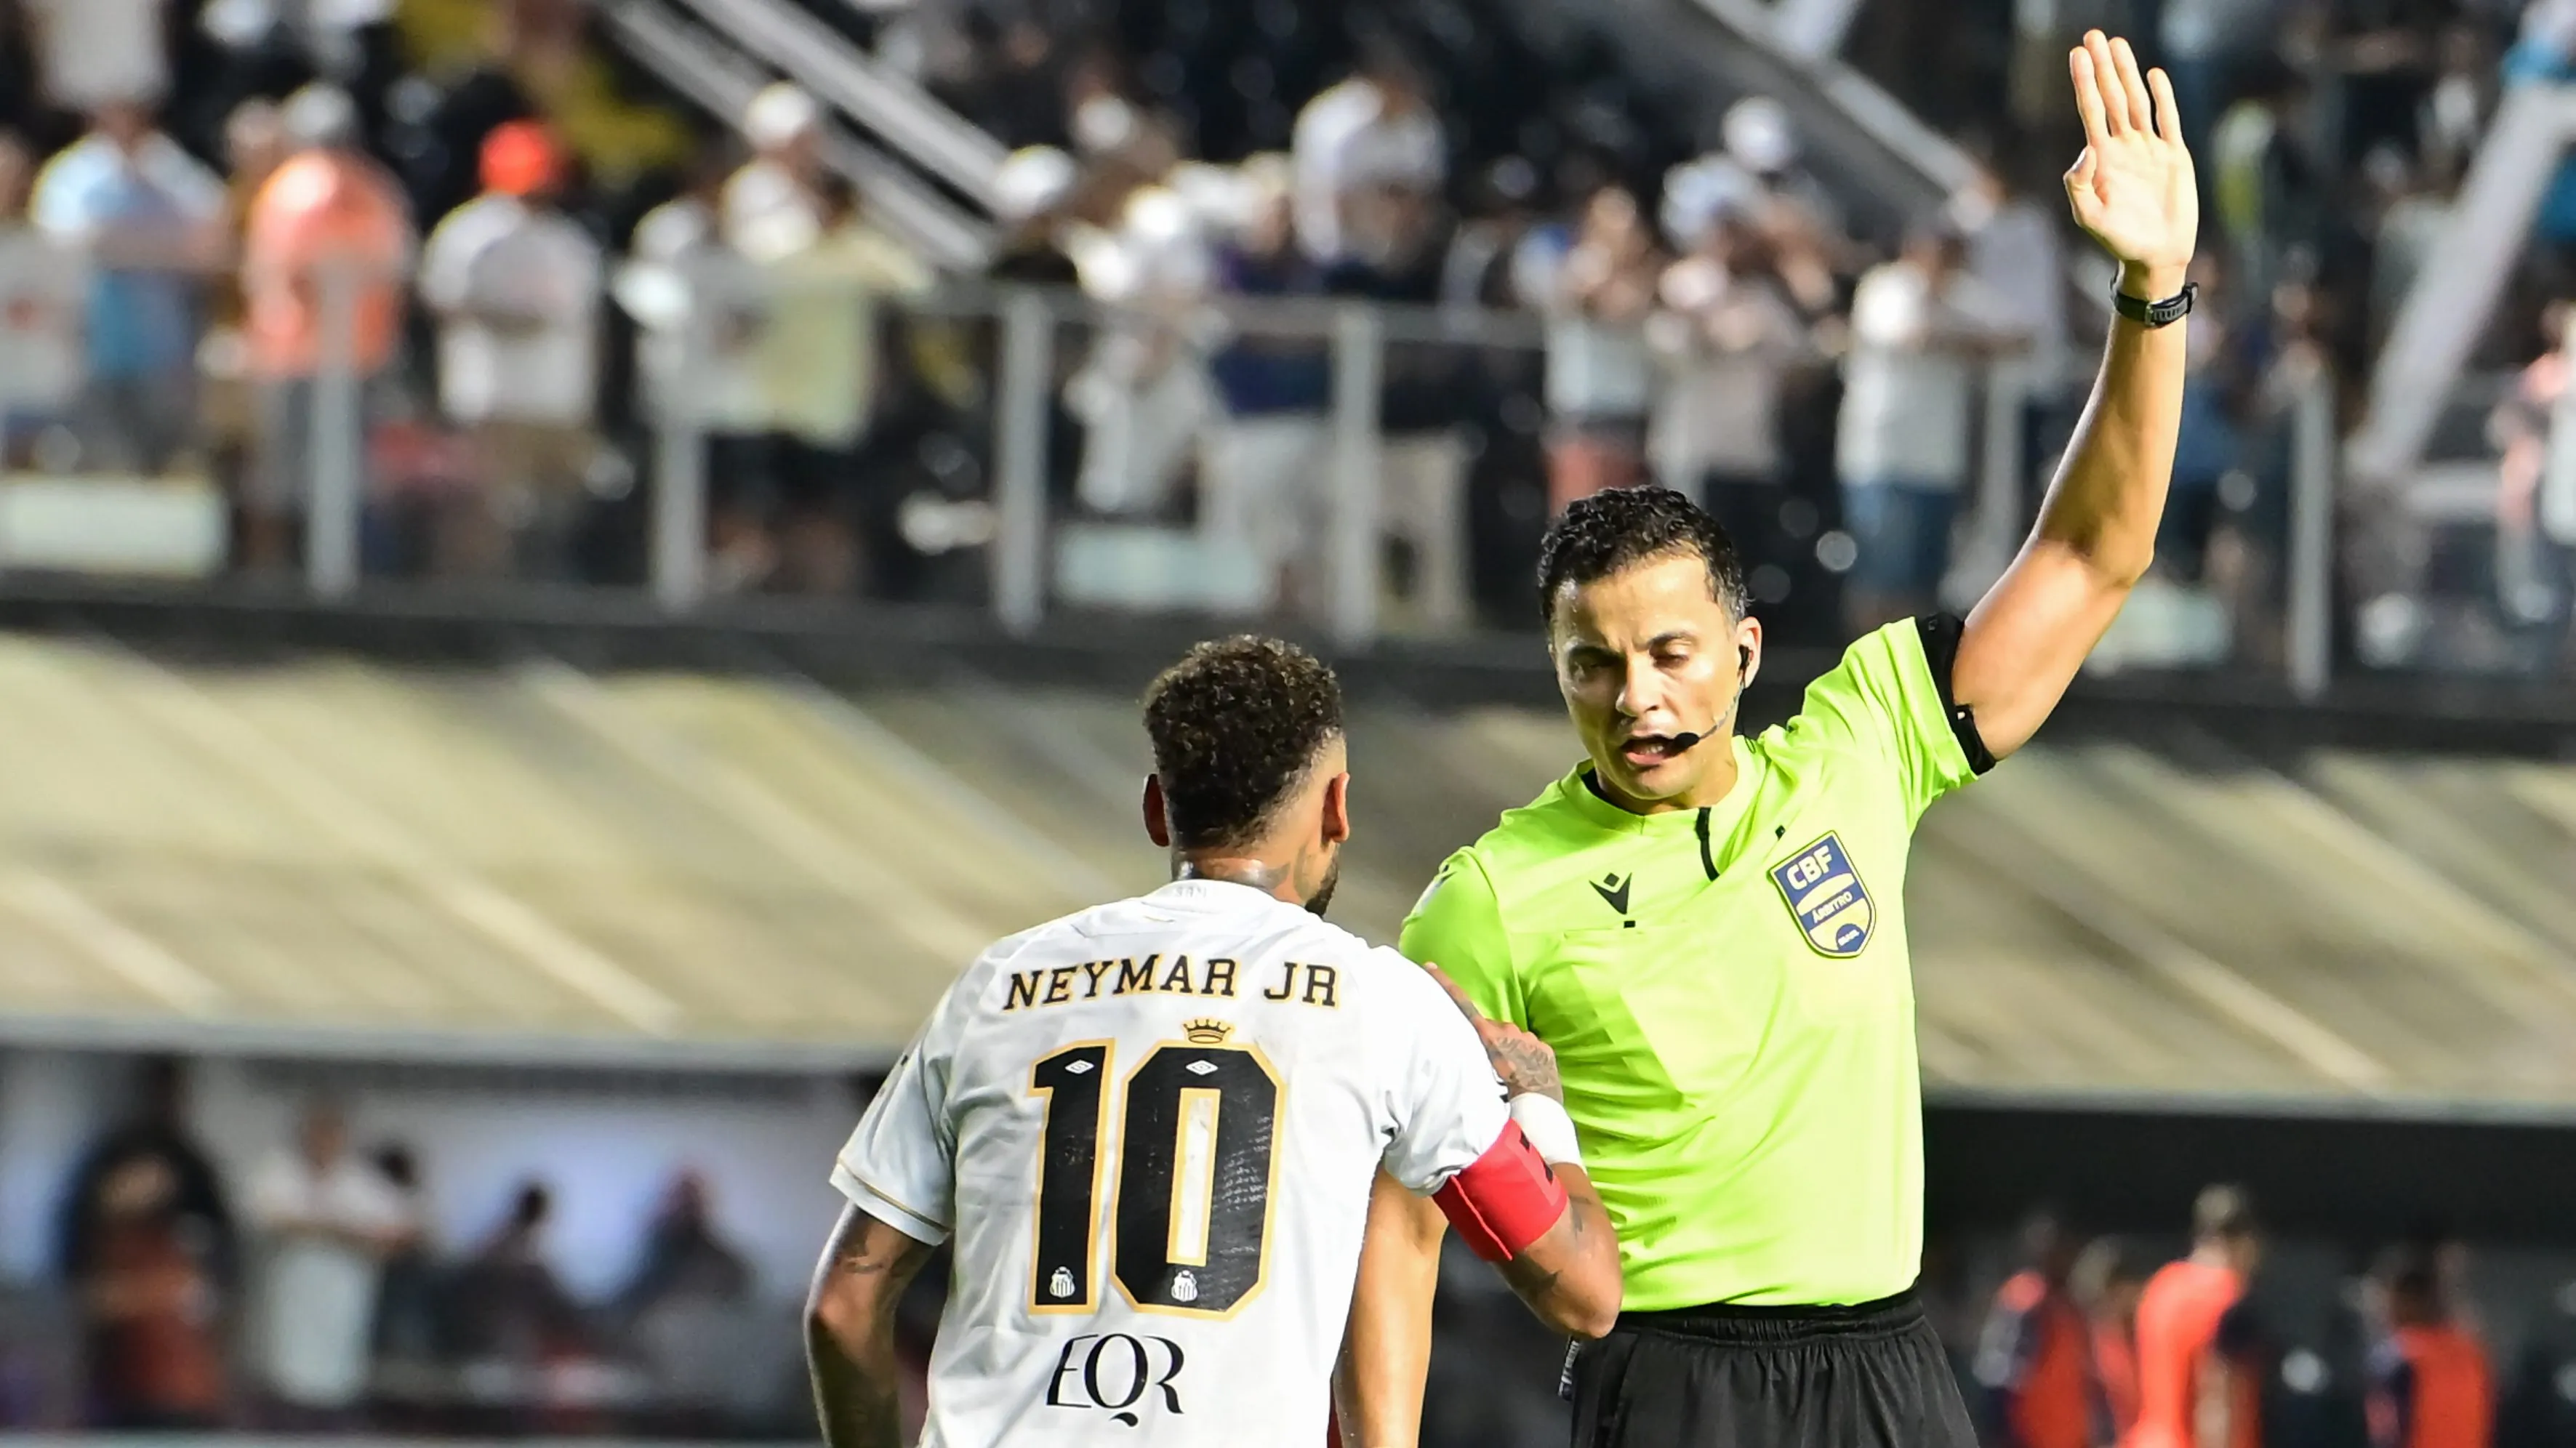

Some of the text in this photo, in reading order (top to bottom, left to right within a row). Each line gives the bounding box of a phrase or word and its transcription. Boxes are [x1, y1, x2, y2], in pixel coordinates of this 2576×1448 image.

[1786, 845, 1832, 890] CBF
[1003, 953, 1339, 1012] NEYMAR JR
[1028, 1039, 1285, 1319] 10
[1046, 1333, 1185, 1427] EQR
